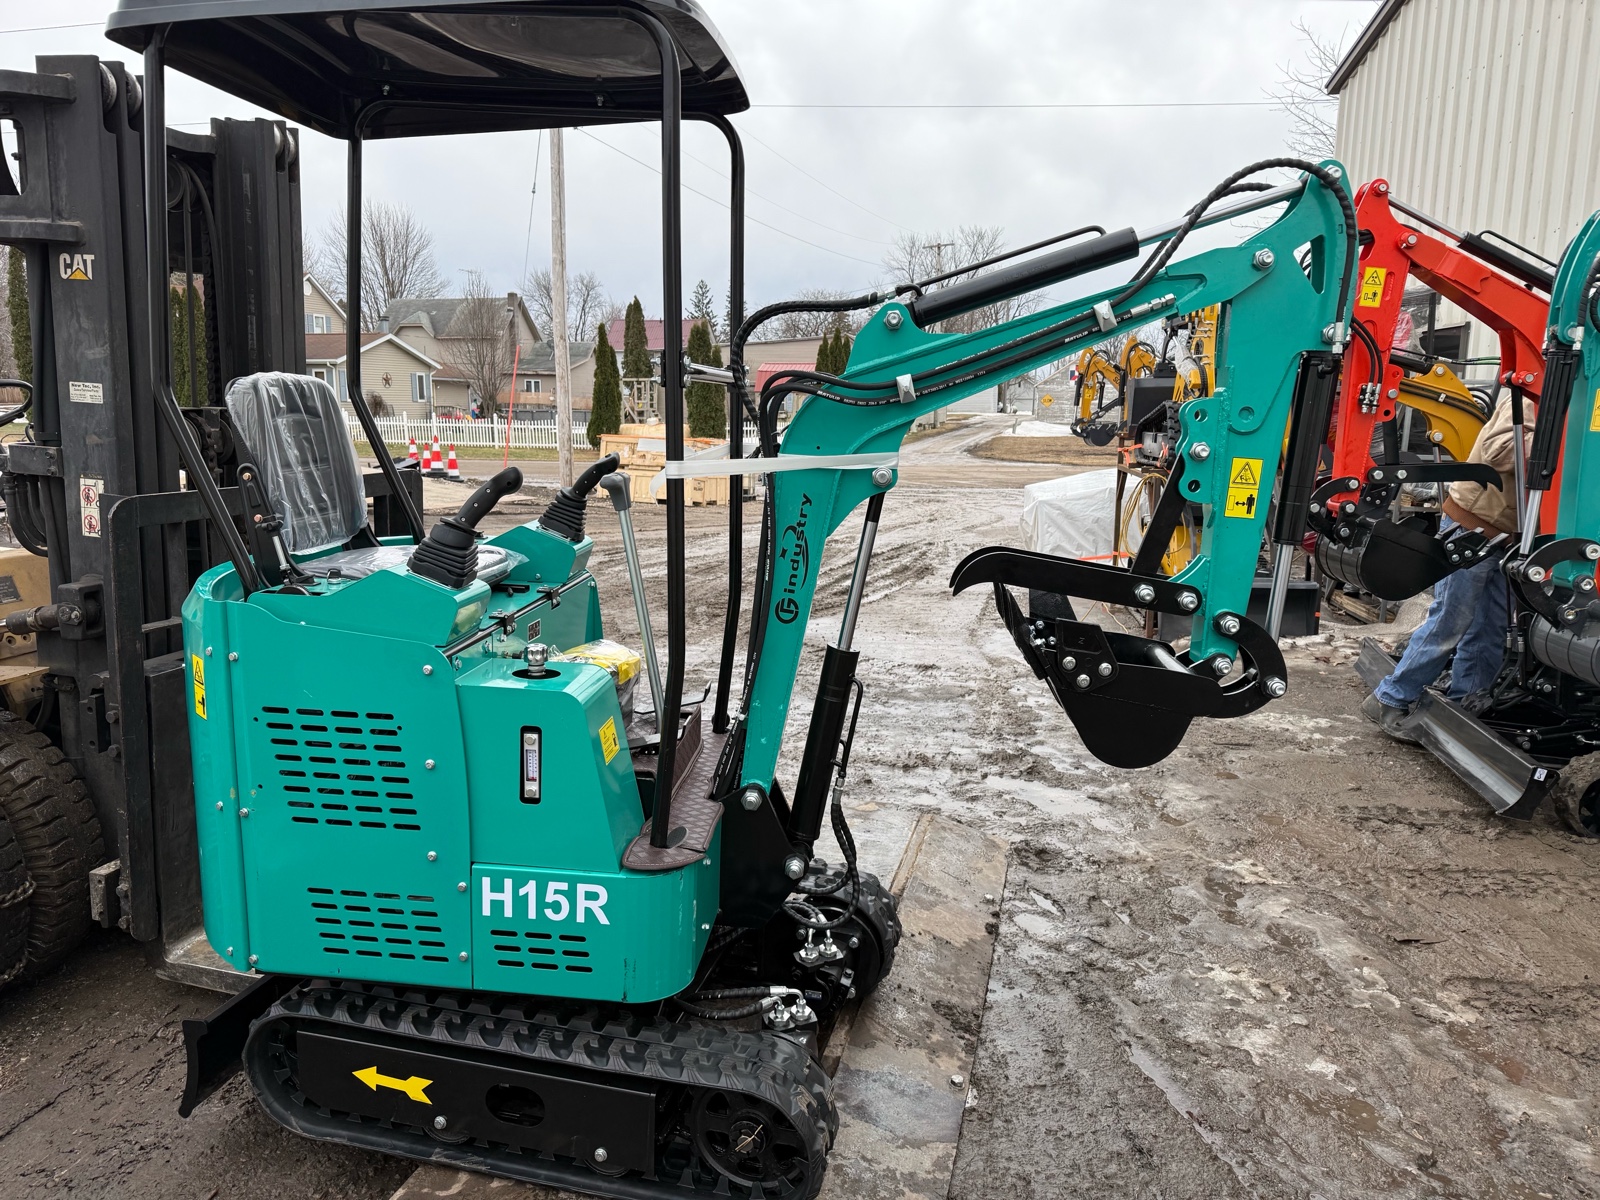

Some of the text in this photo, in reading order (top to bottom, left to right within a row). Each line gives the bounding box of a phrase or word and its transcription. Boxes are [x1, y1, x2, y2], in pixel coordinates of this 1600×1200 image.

[59, 253, 95, 280] CAT
[775, 493, 812, 624] Gindustry
[482, 876, 610, 925] H15R
